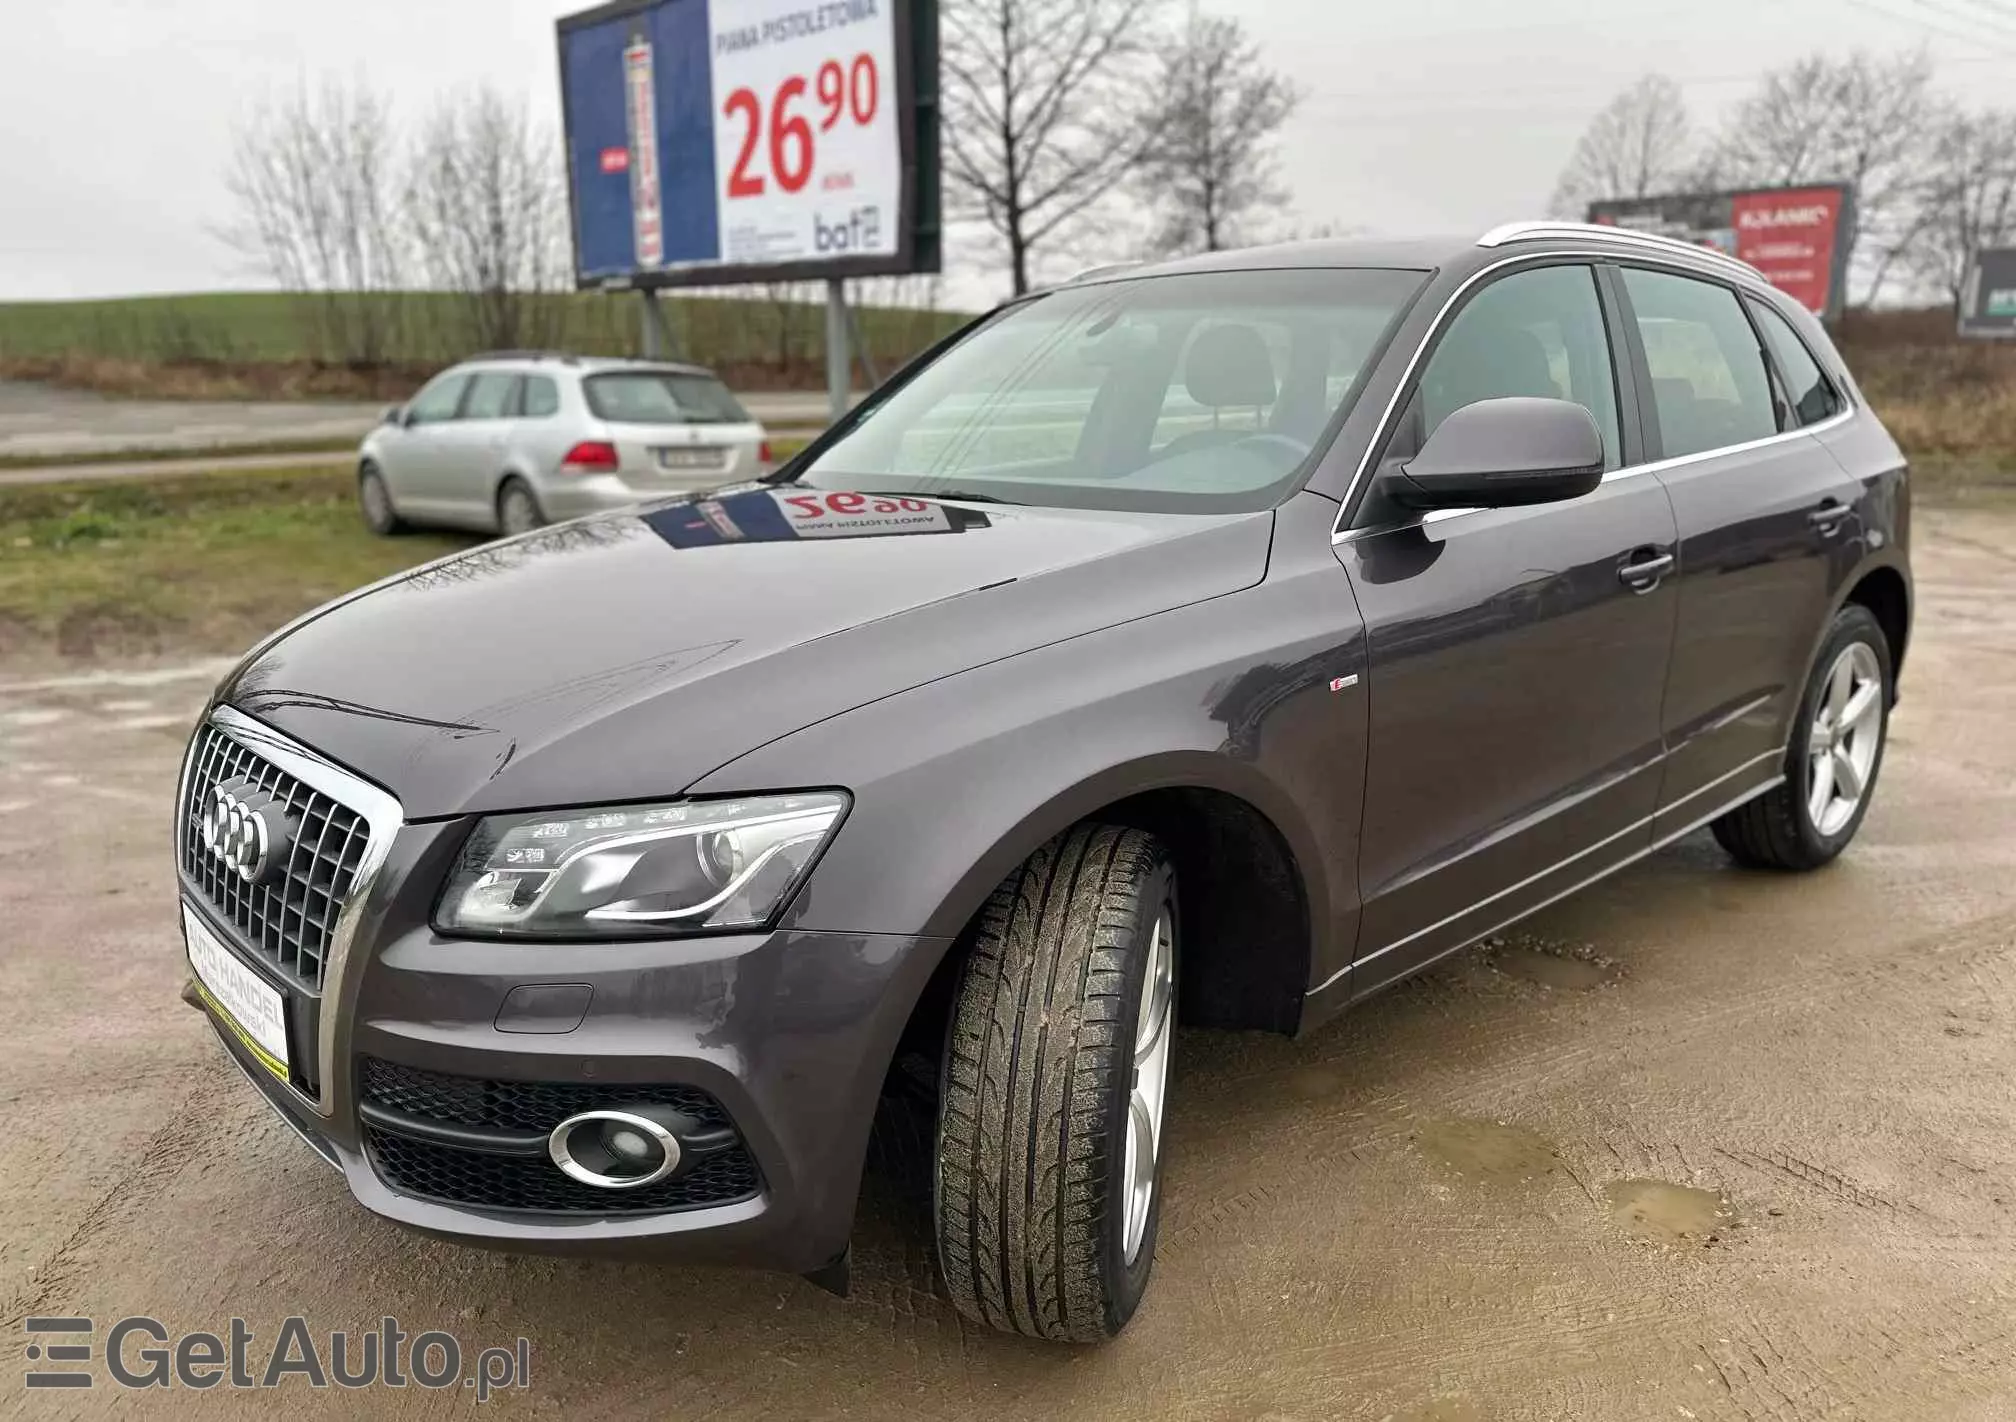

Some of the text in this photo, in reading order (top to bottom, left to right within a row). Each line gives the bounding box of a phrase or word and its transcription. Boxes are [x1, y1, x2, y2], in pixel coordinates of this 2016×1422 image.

[715, 0, 879, 53] PIANA PISTOLETOWA
[723, 75, 815, 199] 26
[816, 51, 879, 134] 90
